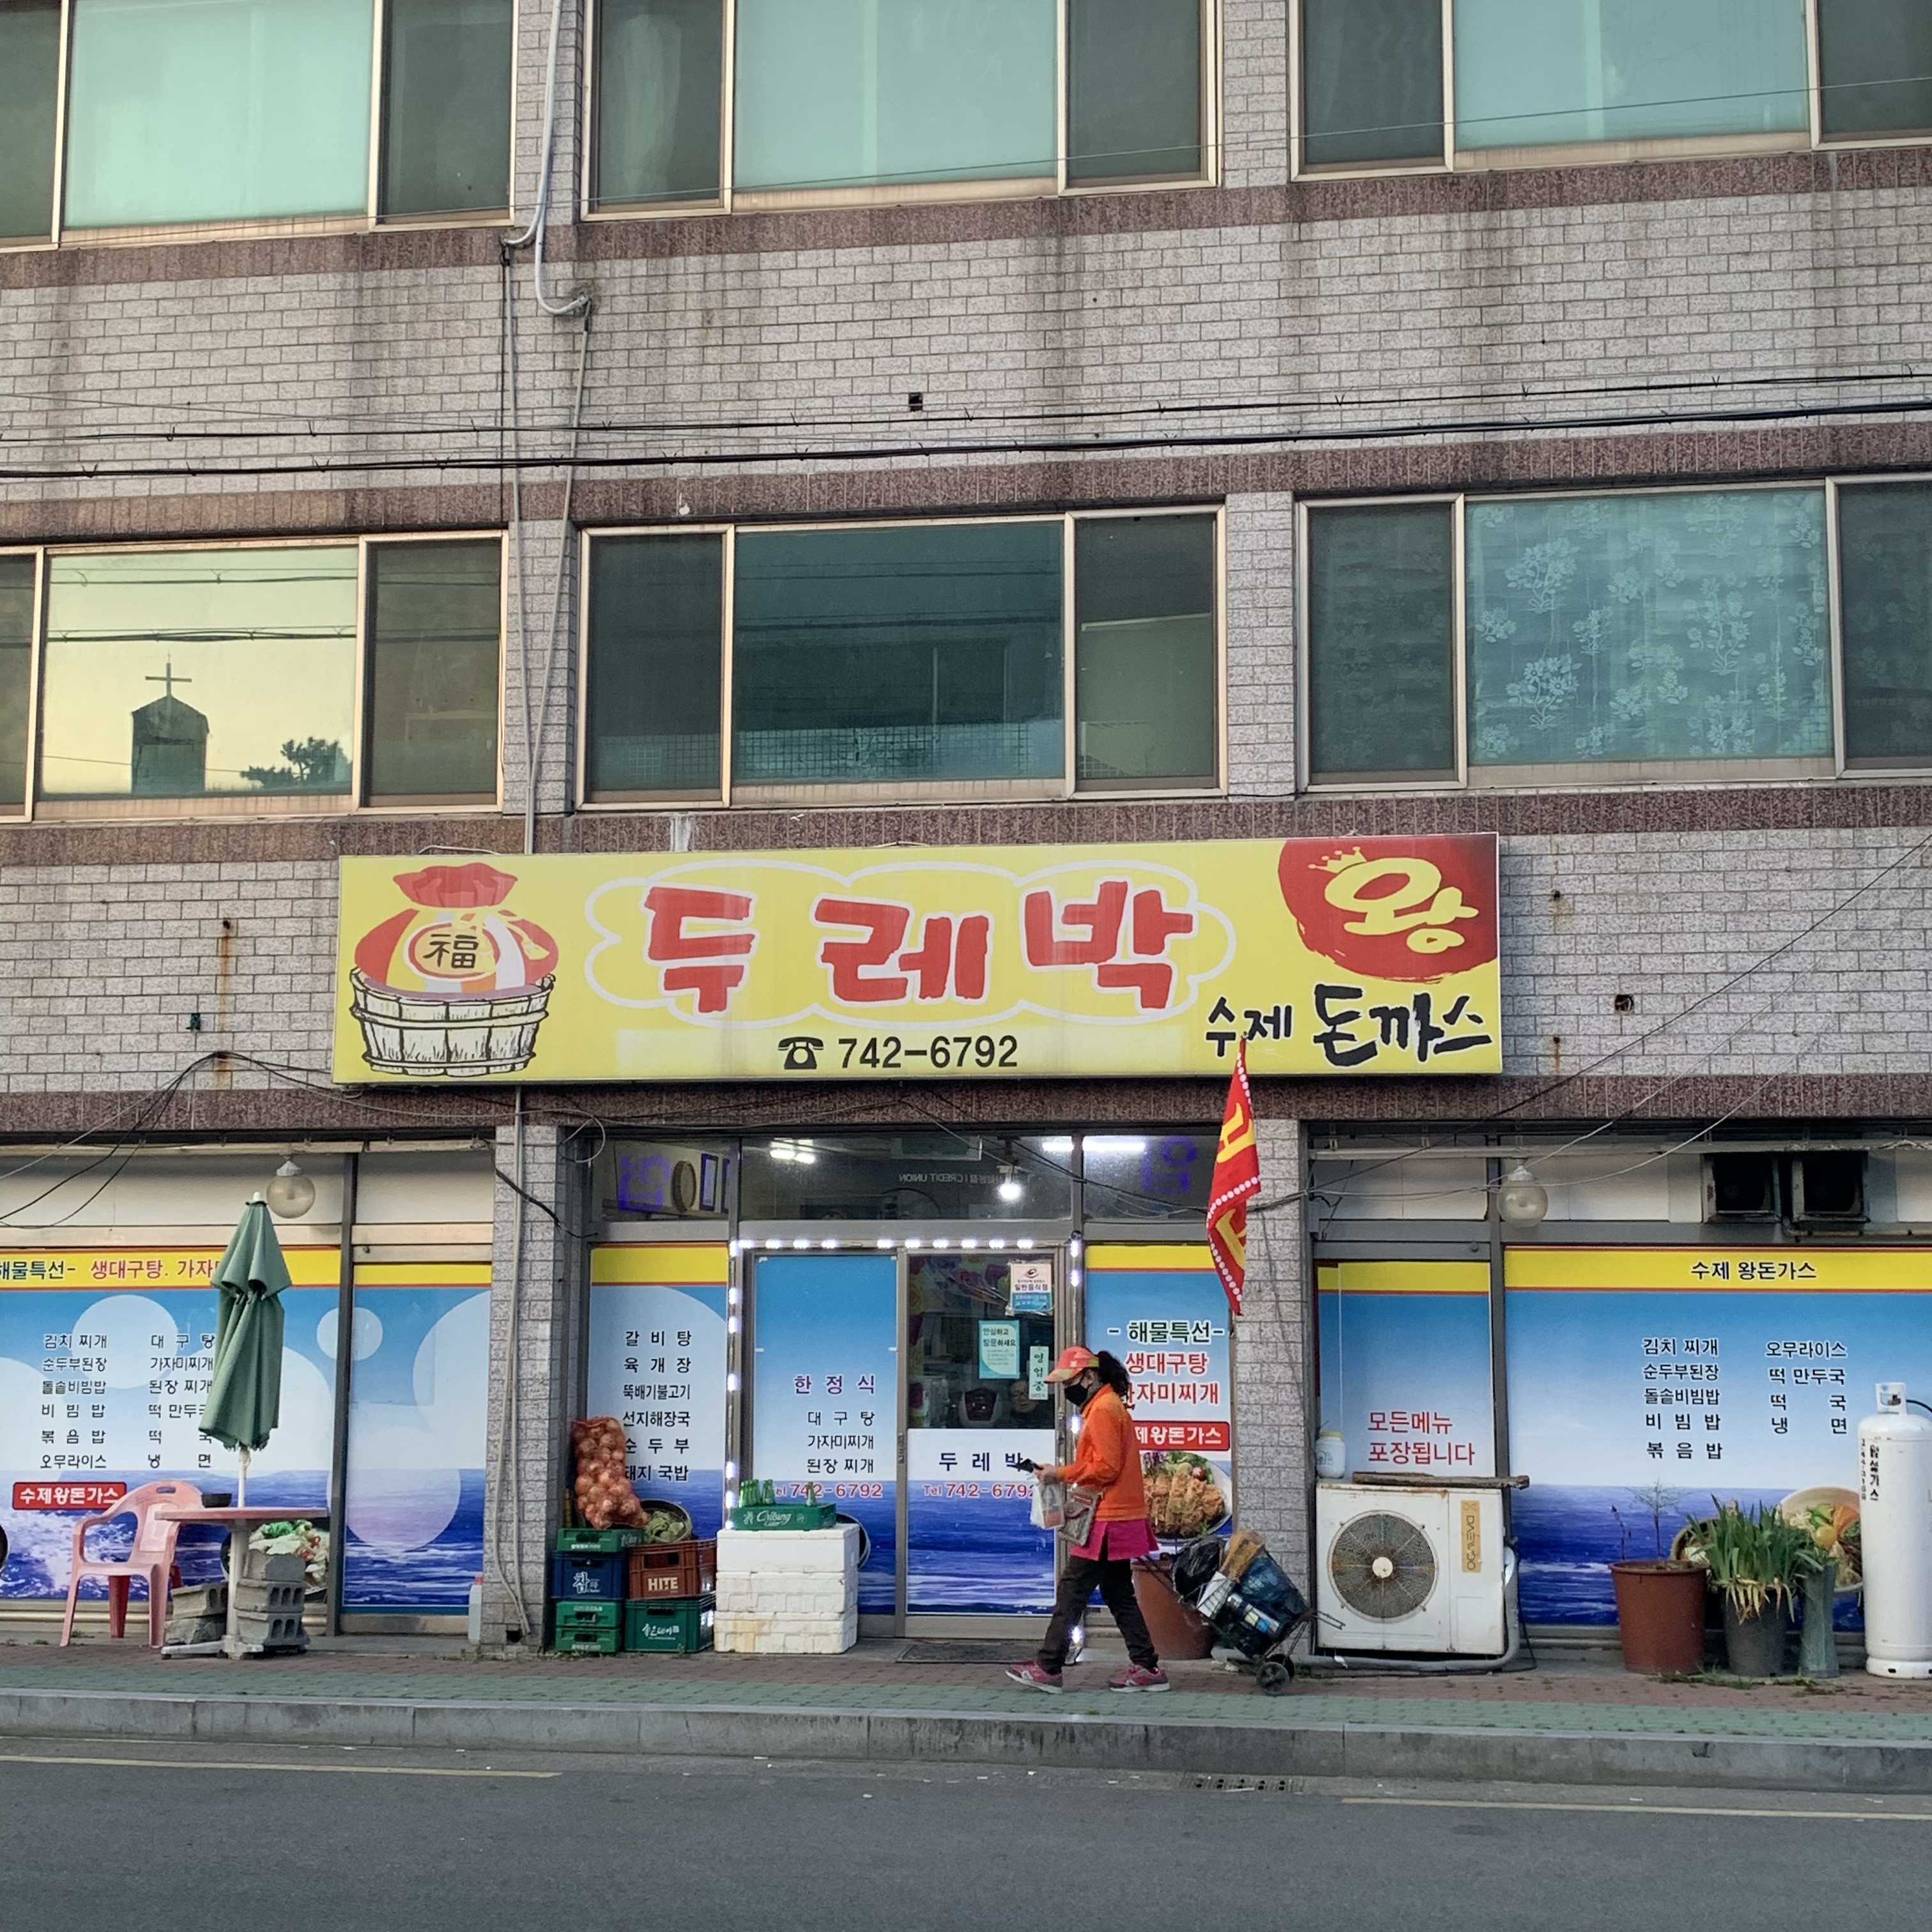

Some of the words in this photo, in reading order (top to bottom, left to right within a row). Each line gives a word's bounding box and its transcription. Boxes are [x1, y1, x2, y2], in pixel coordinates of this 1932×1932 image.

[1324, 857, 1478, 954] 왕
[431, 932, 479, 969] 福
[645, 879, 1194, 1014] 두레박
[1205, 996, 1292, 1058] 수제
[1312, 983, 1492, 1067] 돈까스
[838, 1034, 1018, 1070] 742-6792
[177, 1259, 218, 1280] 가자
[1690, 1261, 1729, 1280] 수제
[1738, 1261, 1817, 1280] 왕돈가스
[43, 1334, 72, 1349] 김치
[79, 1334, 108, 1349] 찌개
[625, 1330, 693, 1347] 갈비탕
[983, 1338, 1016, 1347] 방문하세요
[1643, 1338, 1676, 1356] 김치
[1683, 1338, 1719, 1356] 찌개
[1766, 1342, 1847, 1358] 오무라이스
[42, 1357, 107, 1372] 순두부된장
[150, 1357, 214, 1372] 가자미찌개
[624, 1356, 692, 1374] 육개장
[1126, 1353, 1208, 1375] 생대구탕
[1643, 1363, 1719, 1381] 순두부된장
[793, 1374, 875, 1395] 한정식
[1769, 1367, 1785, 1384] 떡
[1793, 1368, 1846, 1385] 만두국
[149, 1379, 179, 1395] 된장
[184, 1379, 213, 1394] 찌개
[622, 1383, 691, 1400] 뚝배기불고기
[41, 1404, 107, 1418] 비빔밥
[148, 1404, 161, 1419] 떡
[622, 1410, 691, 1428] 선지해장국
[807, 1411, 875, 1427] 대구탕
[1367, 1411, 1453, 1434] 모든메뉴
[1645, 1413, 1721, 1430] 비빔밥
[807, 1434, 875, 1450] 가자미찌개
[1134, 1426, 1222, 1445] 제왕돈가스
[1368, 1441, 1475, 1466] 포장됩니다
[1646, 1441, 1723, 1460] 볶음밥
[40, 1454, 107, 1469] 오무라이스
[806, 1458, 839, 1475] 된장
[843, 1458, 874, 1474] 찌개
[657, 1464, 689, 1482] 국밥
[20, 1487, 119, 1505] 수제왕돈가스
[923, 1483, 942, 1496] Tel
[1466, 1515, 1476, 1571] DAEWOO
[572, 1571, 590, 1595] 참
[647, 1576, 678, 1592] HITE
